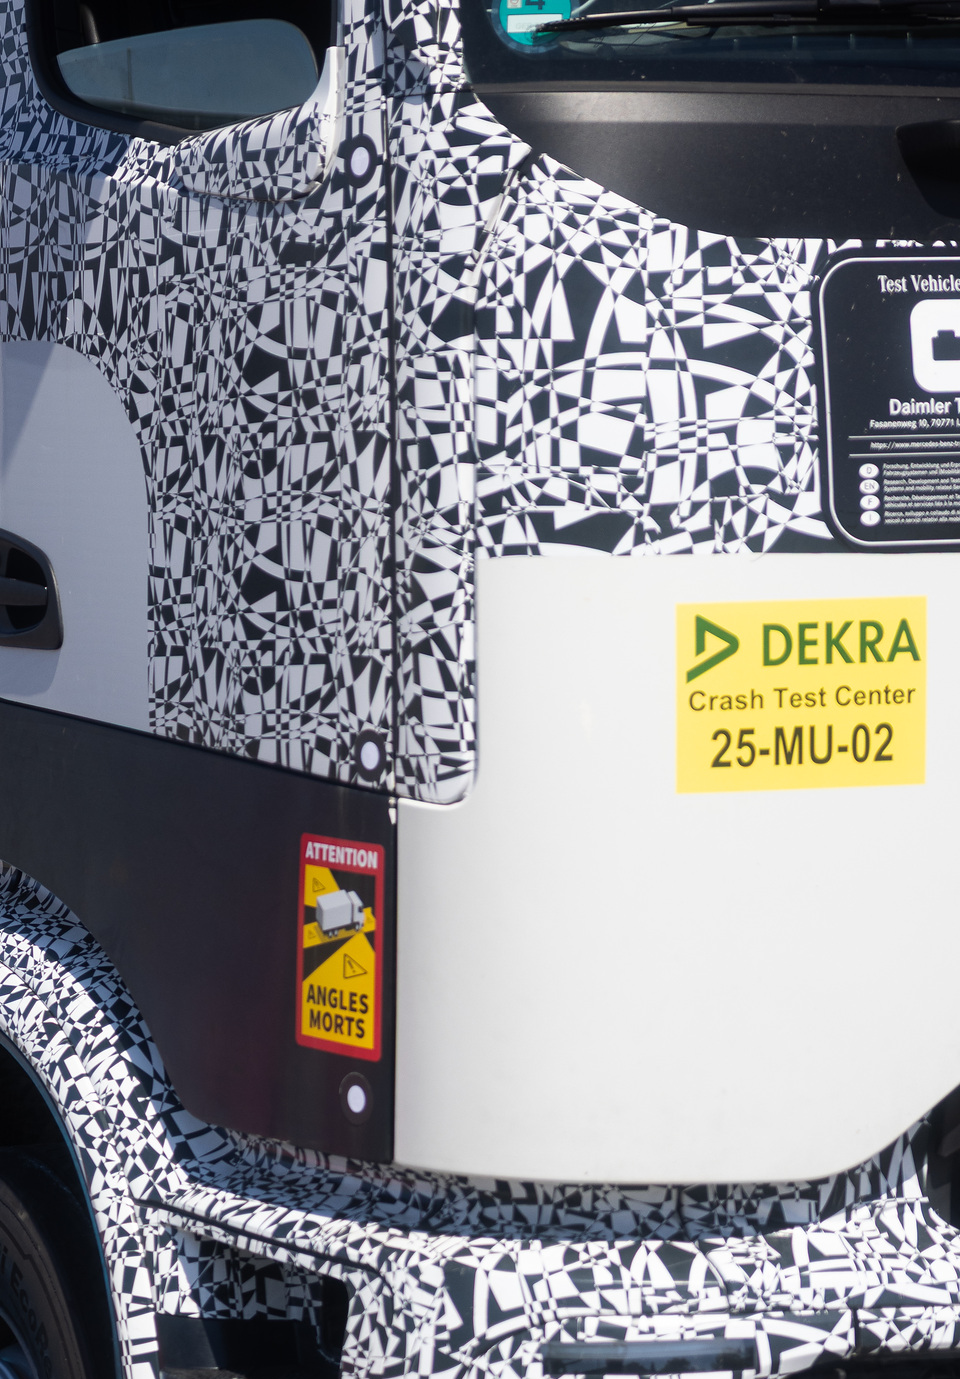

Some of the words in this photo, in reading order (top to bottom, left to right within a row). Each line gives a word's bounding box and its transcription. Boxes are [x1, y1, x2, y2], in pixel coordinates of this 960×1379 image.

[877, 274, 908, 292] Test
[889, 397, 952, 416] Daimler
[869, 419, 917, 430] Fasanenweg
[930, 418, 955, 428] 70771
[762, 617, 921, 667] DEKRA
[688, 688, 764, 712] Crash
[773, 686, 827, 708] Test
[834, 684, 916, 707] Center
[711, 721, 895, 769] 25-MU-02
[305, 841, 379, 869] ATTENTION
[306, 983, 370, 1015] ANGLES
[308, 1007, 366, 1039] MORTS
